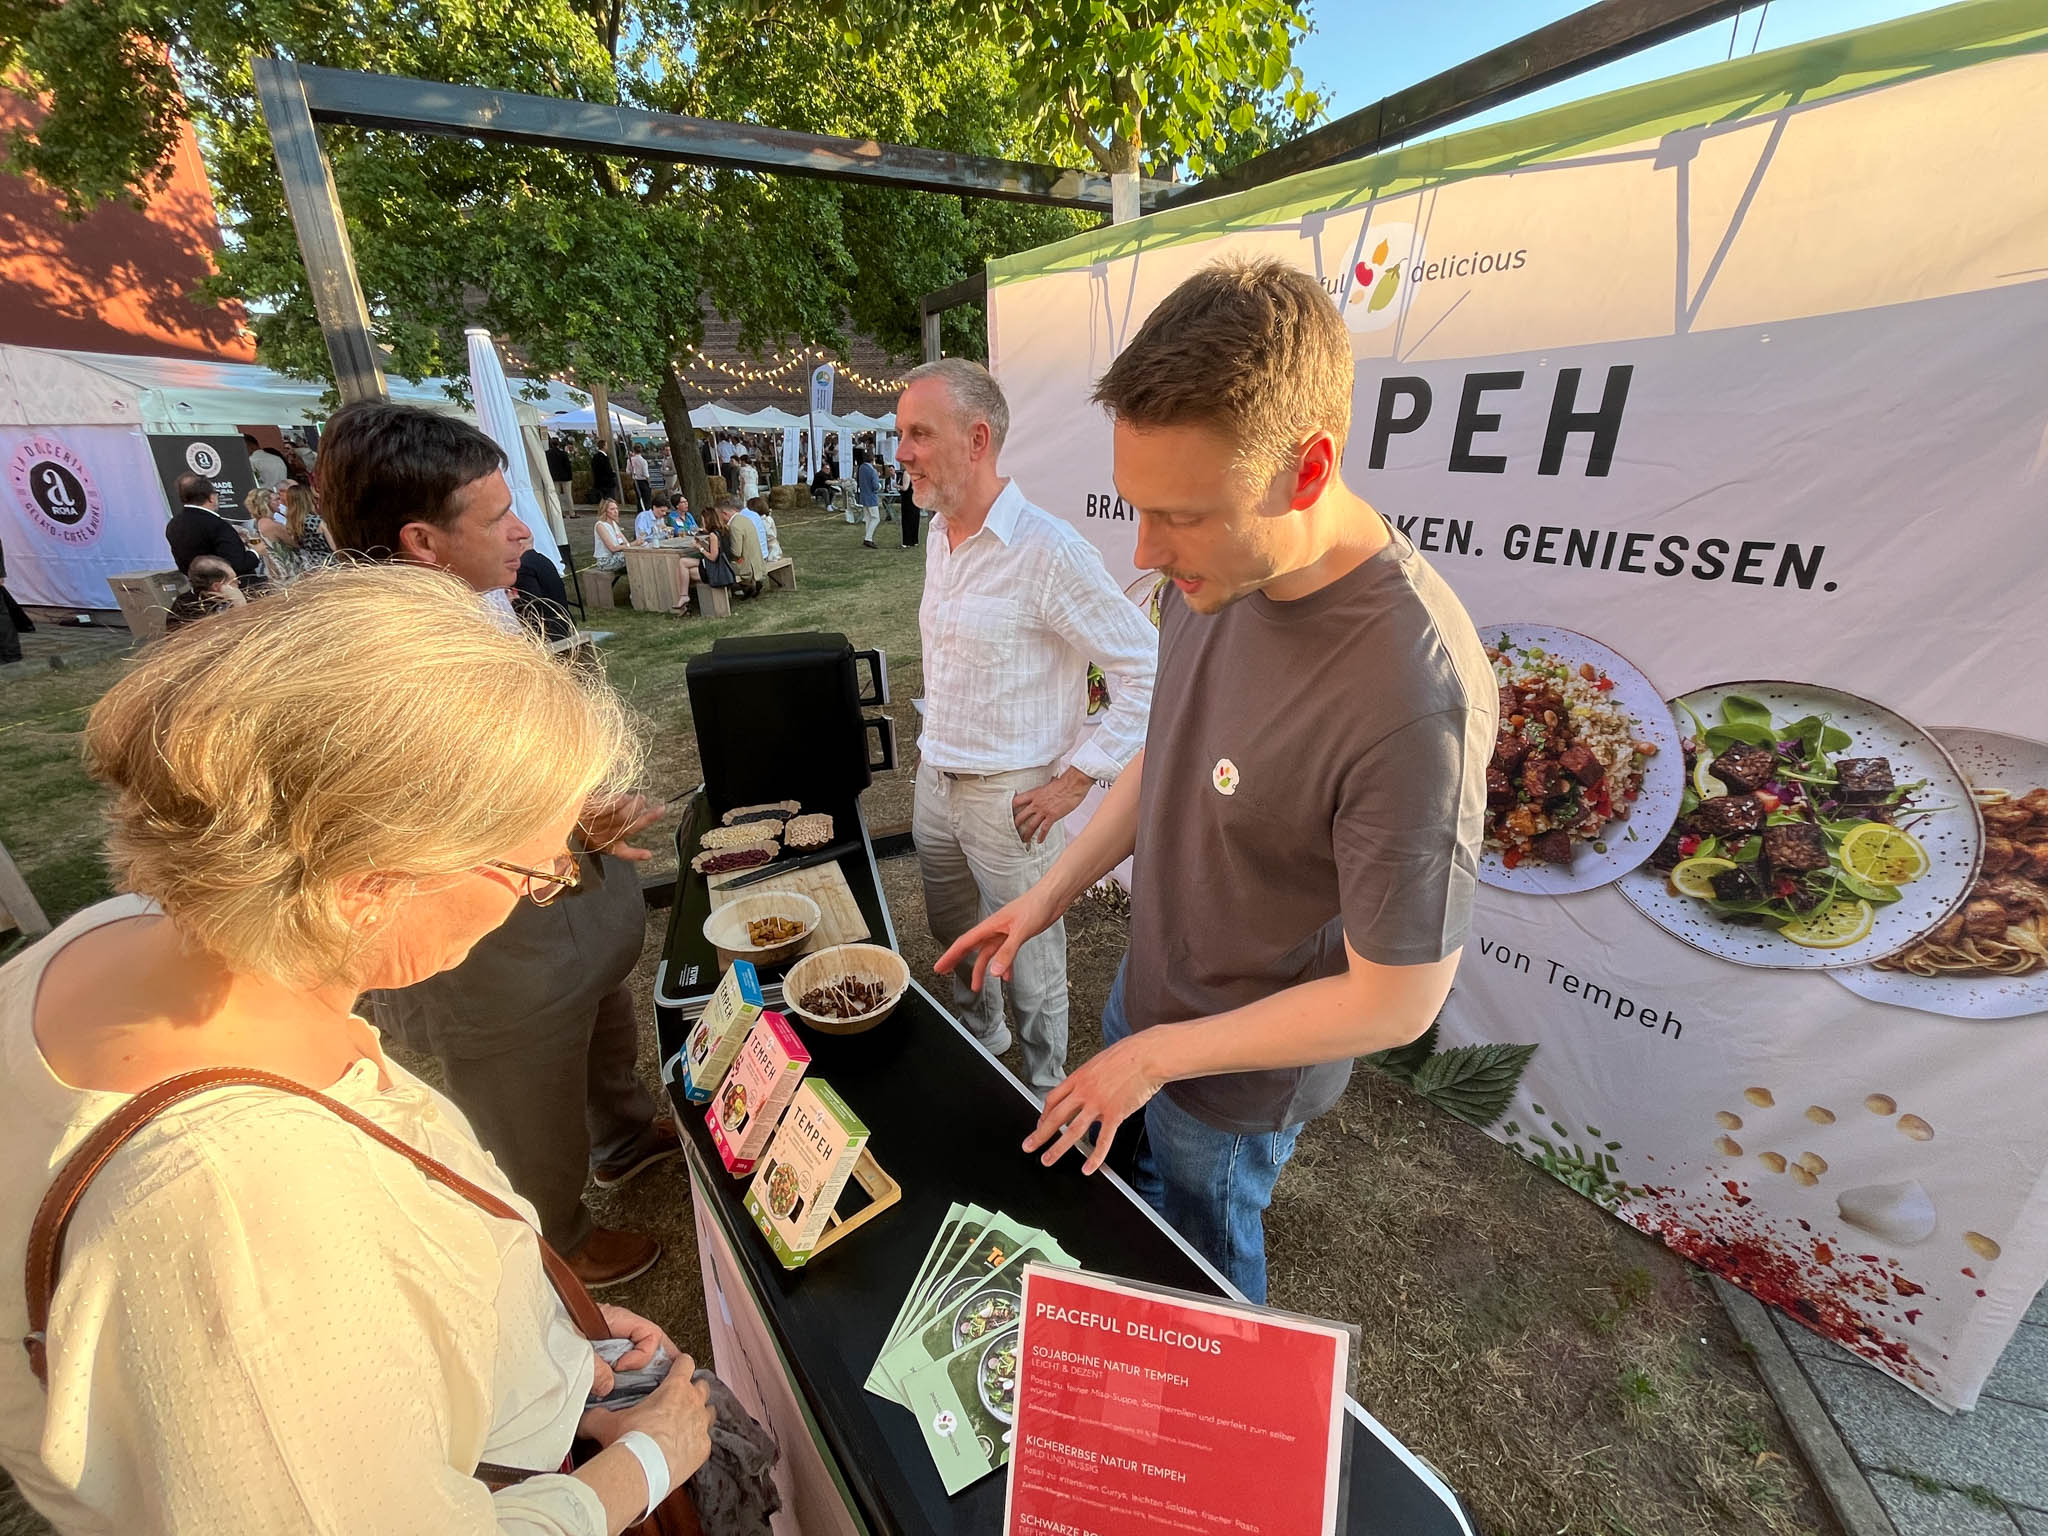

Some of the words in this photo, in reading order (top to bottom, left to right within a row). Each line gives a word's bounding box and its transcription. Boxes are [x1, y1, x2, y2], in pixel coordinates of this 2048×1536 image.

[1411, 249, 1528, 283] delicious
[1368, 365, 1634, 477] PEH
[1382, 513, 1483, 557] KEN.
[1503, 524, 1838, 592] GENIESSEN.
[720, 980, 734, 1020] TEMPEH
[1480, 937, 1531, 973] von
[1547, 959, 1683, 1040] Tempeh
[750, 1035, 777, 1081] TEMPEH
[793, 1105, 833, 1161] TEMPEH
[1035, 1302, 1121, 1334] PEACEFUL
[1126, 1321, 1222, 1355] DELICIOUS
[1031, 1358, 1059, 1371] LEICHT
[1062, 1365, 1069, 1373] &
[1071, 1366, 1103, 1379] DEZENT
[1032, 1345, 1101, 1368] SOJABOHNE
[1103, 1359, 1141, 1377] NATUR
[1144, 1368, 1189, 1387] TEMPEH
[1030, 1375, 1051, 1388] Passt
[1199, 1414, 1215, 1424] und
[1217, 1418, 1247, 1432] perfekt
[1250, 1425, 1267, 1435] zum
[1024, 1447, 1044, 1459] MILD
[1046, 1453, 1066, 1465] UND
[1025, 1434, 1097, 1463] KICHERERBSE
[1100, 1453, 1138, 1473] NATUR
[1141, 1463, 1187, 1484] TEMPEH
[1023, 1464, 1044, 1477] Passt
[1235, 1519, 1260, 1533] Pasta
[1019, 1512, 1080, 1536] SCHWARZE
